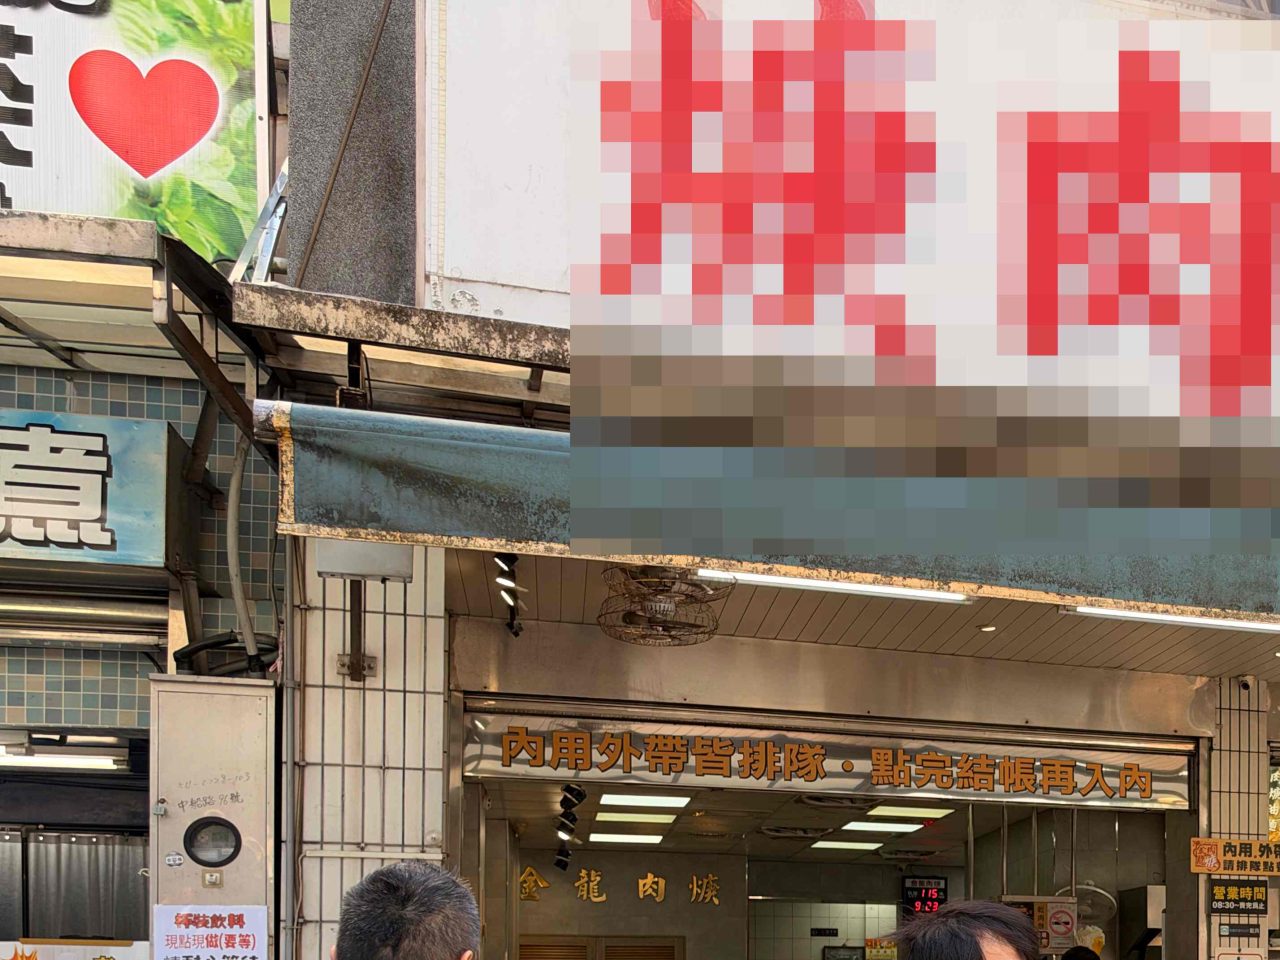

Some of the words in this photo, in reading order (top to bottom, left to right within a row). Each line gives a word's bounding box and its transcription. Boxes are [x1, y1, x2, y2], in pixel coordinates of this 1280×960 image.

[0, 423, 117, 552] 煮
[1213, 886, 1266, 900] 營業時間
[174, 912, 246, 930] 杯裝飲料
[164, 933, 256, 951] 現點現做(要等)
